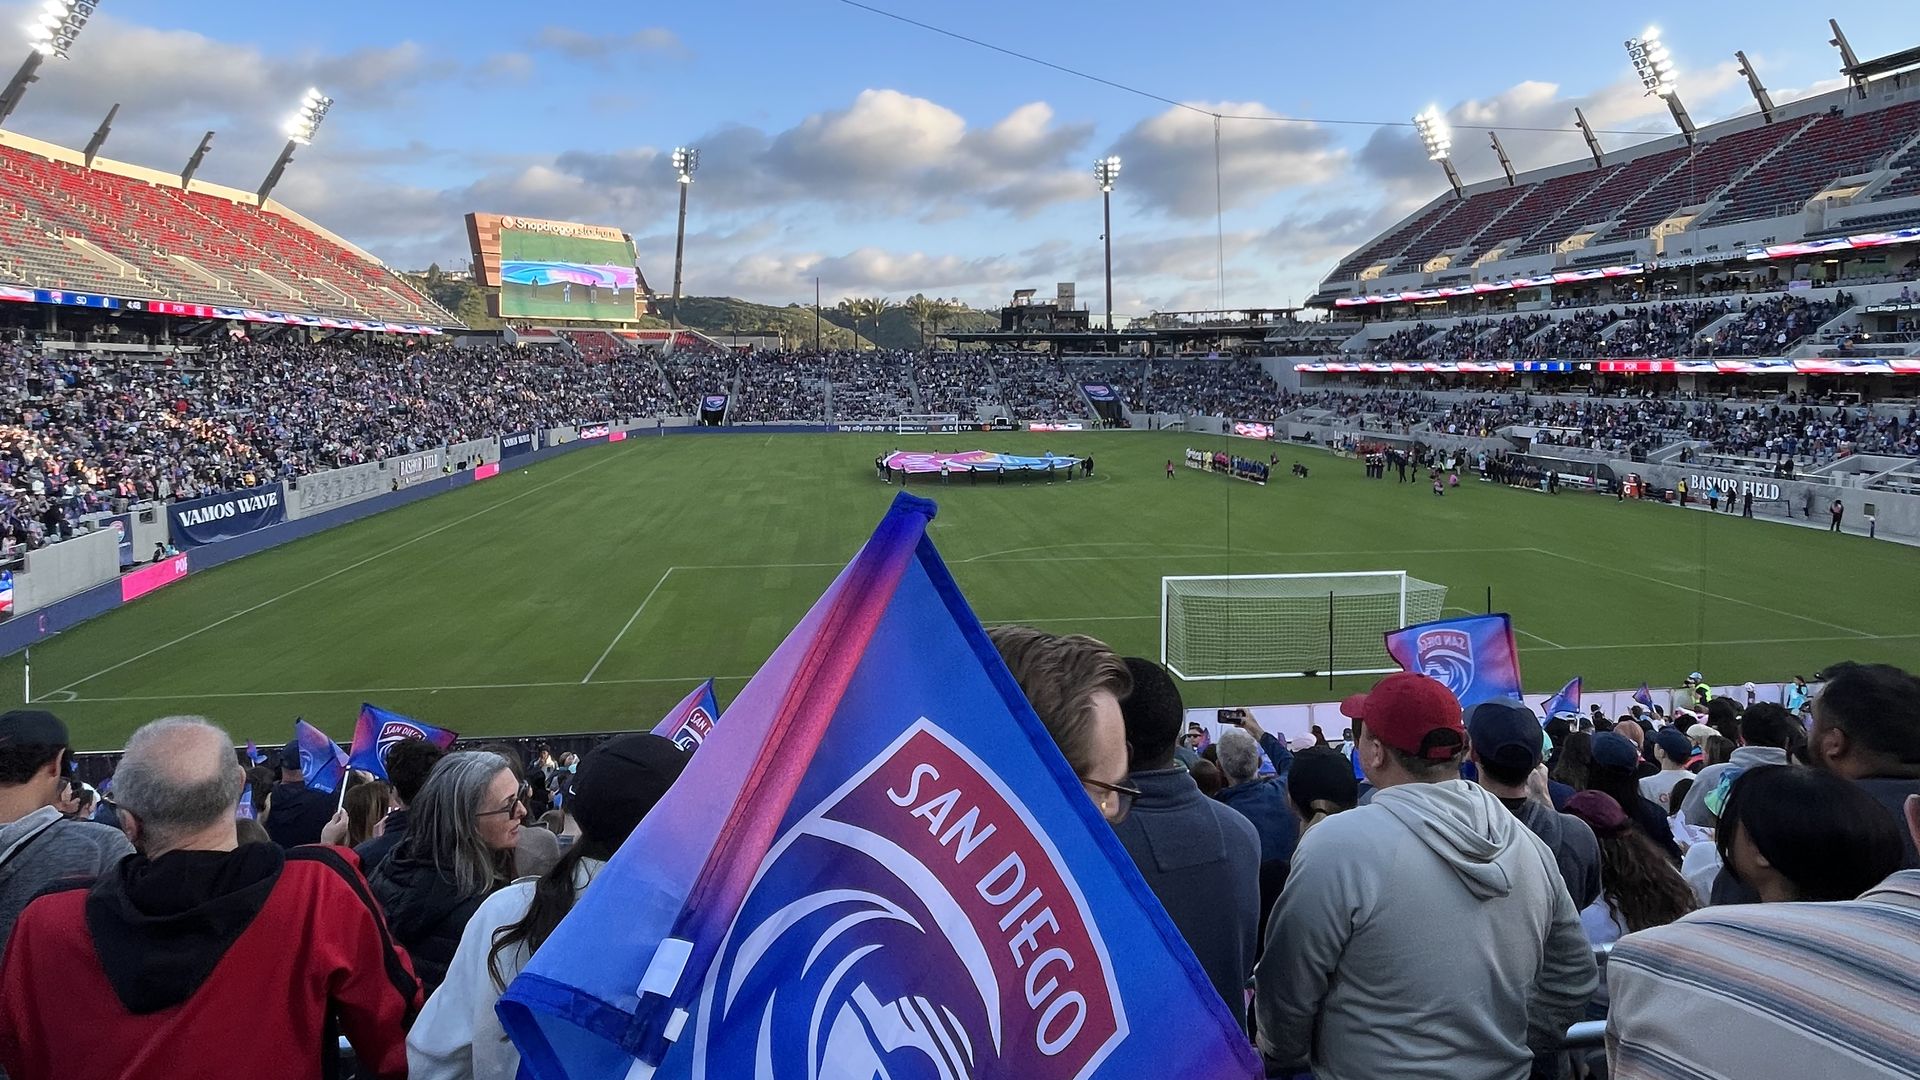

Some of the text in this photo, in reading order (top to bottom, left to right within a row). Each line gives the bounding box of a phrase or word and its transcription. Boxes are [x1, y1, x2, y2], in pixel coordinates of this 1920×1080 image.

[515, 218, 578, 236] Snapdragon
[1742, 481, 1780, 500] FIELD
[179, 492, 278, 527] VAMOS WAVE
[384, 725, 402, 735] SAN
[690, 713, 707, 731] SAN
[886, 763, 1087, 1056] SAN DIEGO
